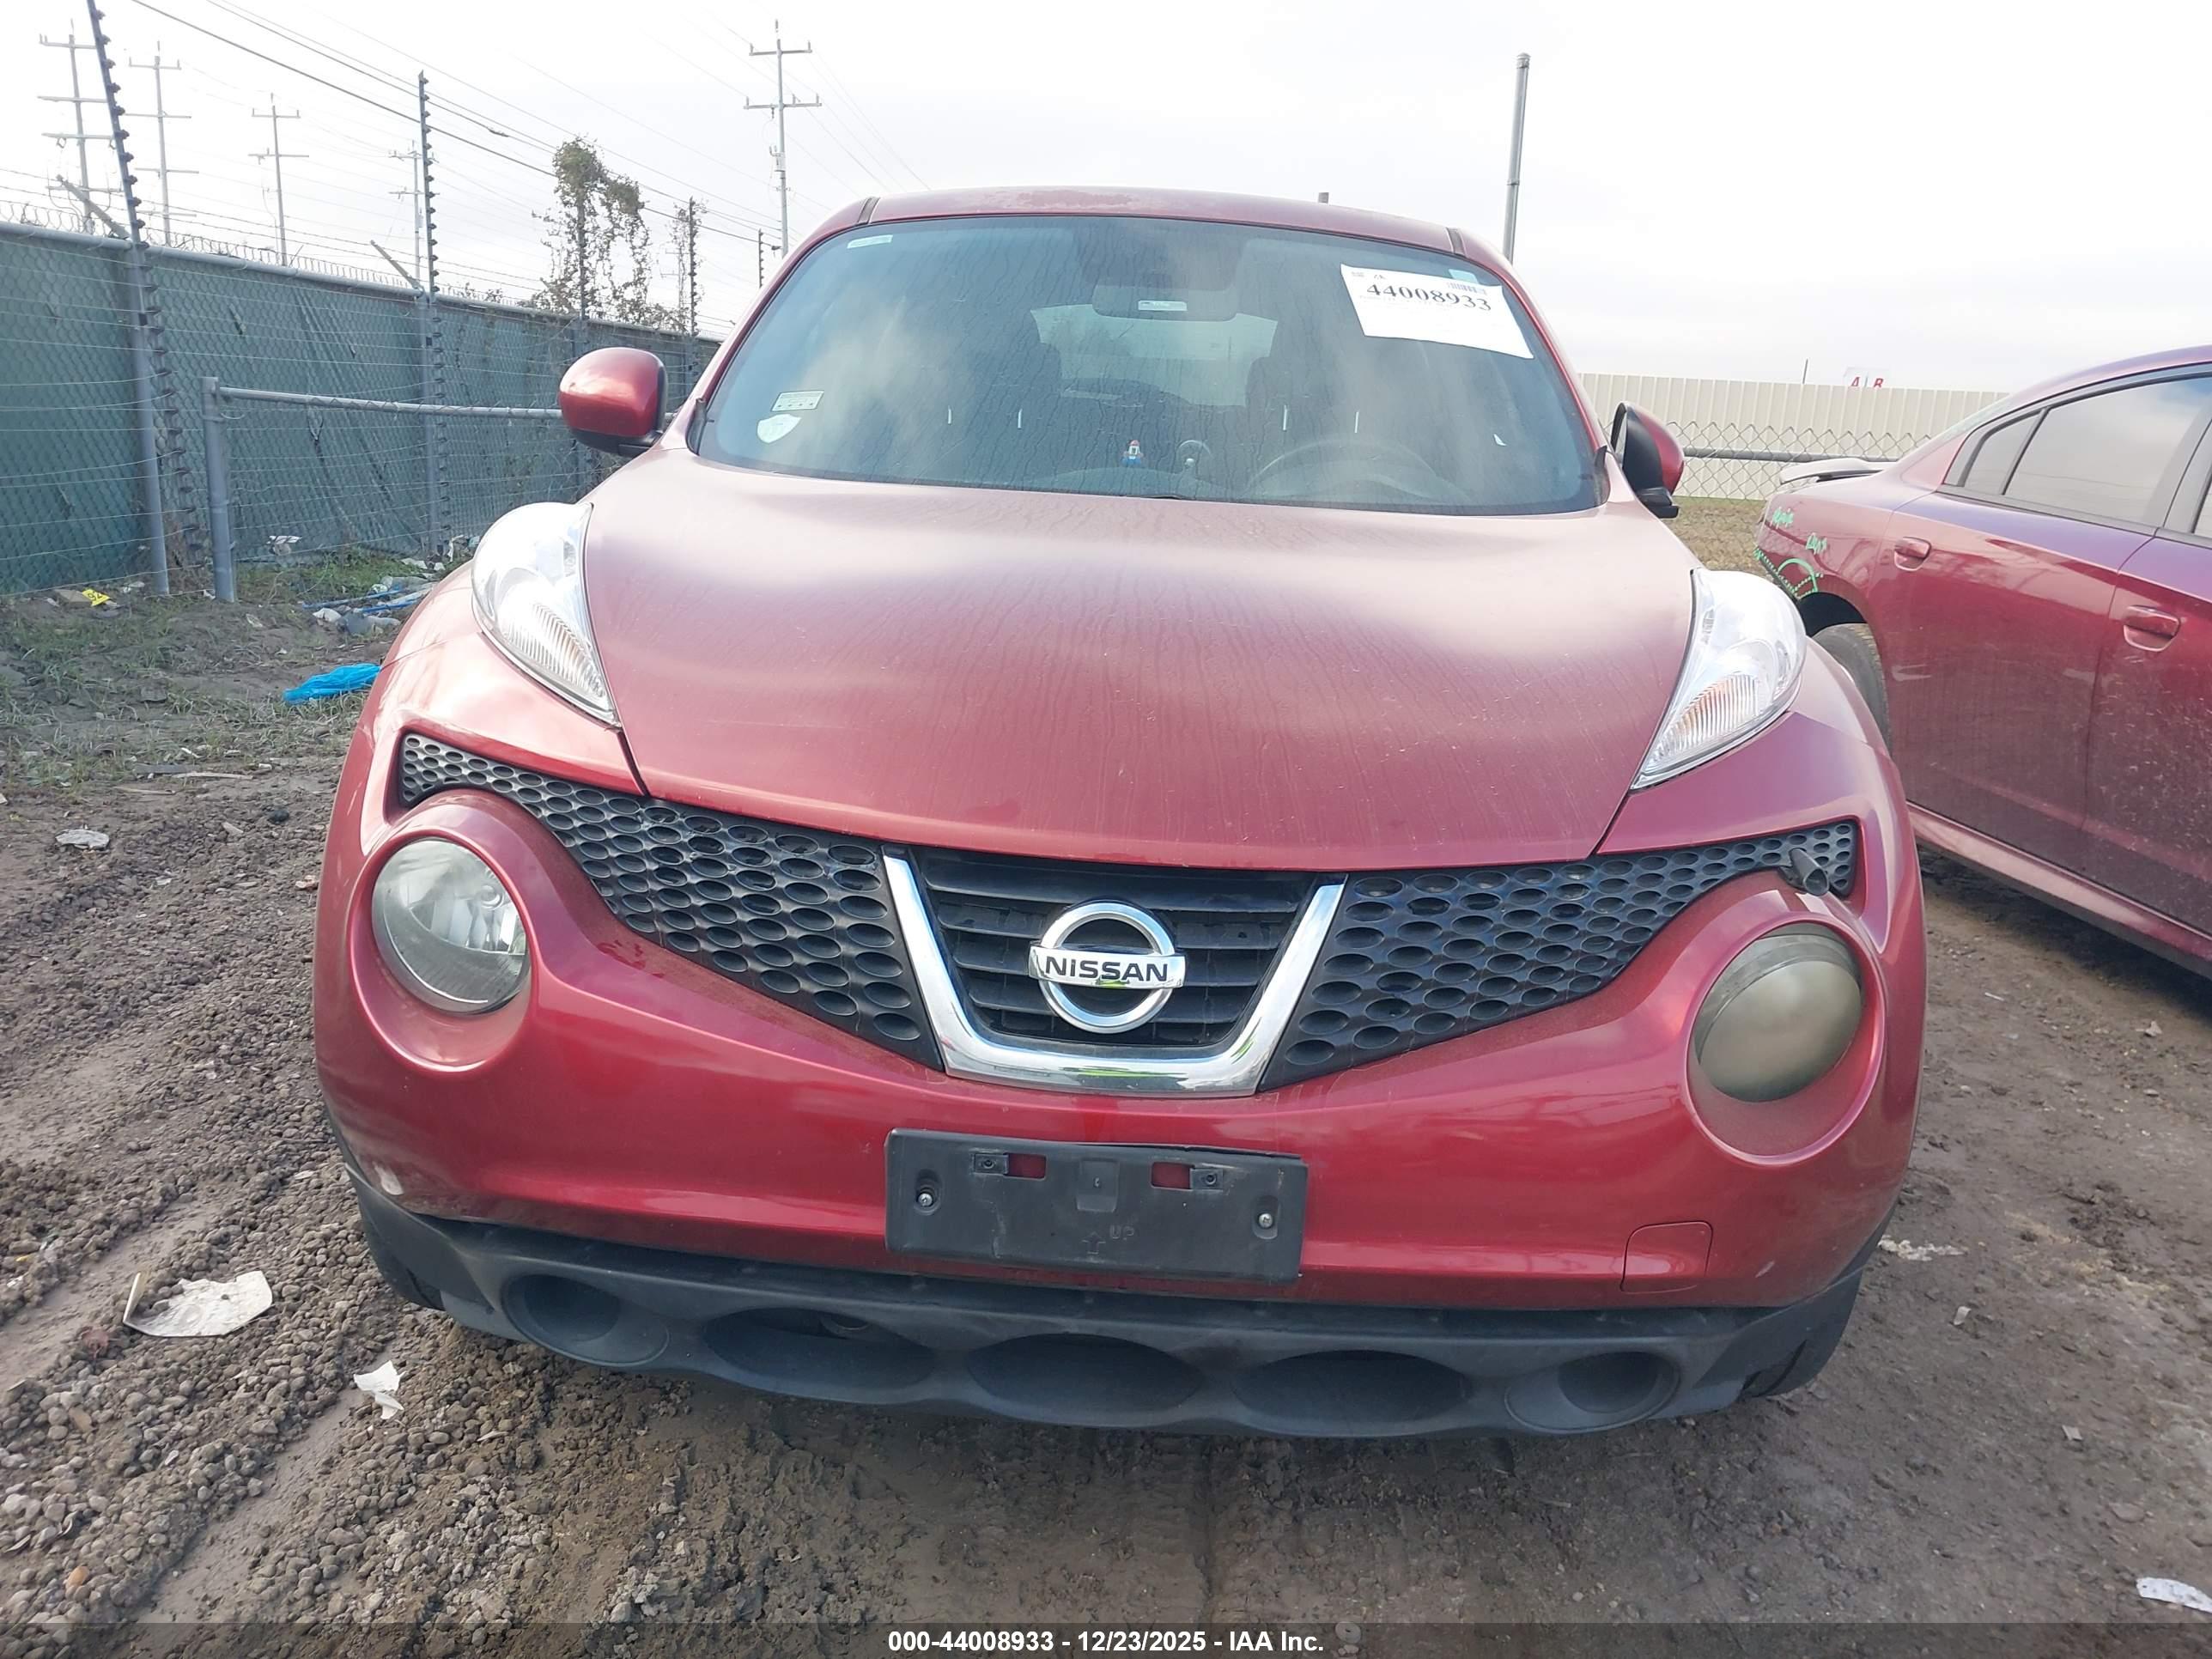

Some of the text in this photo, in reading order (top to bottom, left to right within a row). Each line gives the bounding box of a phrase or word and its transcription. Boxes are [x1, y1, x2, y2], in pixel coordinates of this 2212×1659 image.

[1367, 284, 1492, 311] 44008933
[1045, 956, 1169, 981] NISSAN
[1109, 1224, 1135, 1241] UP
